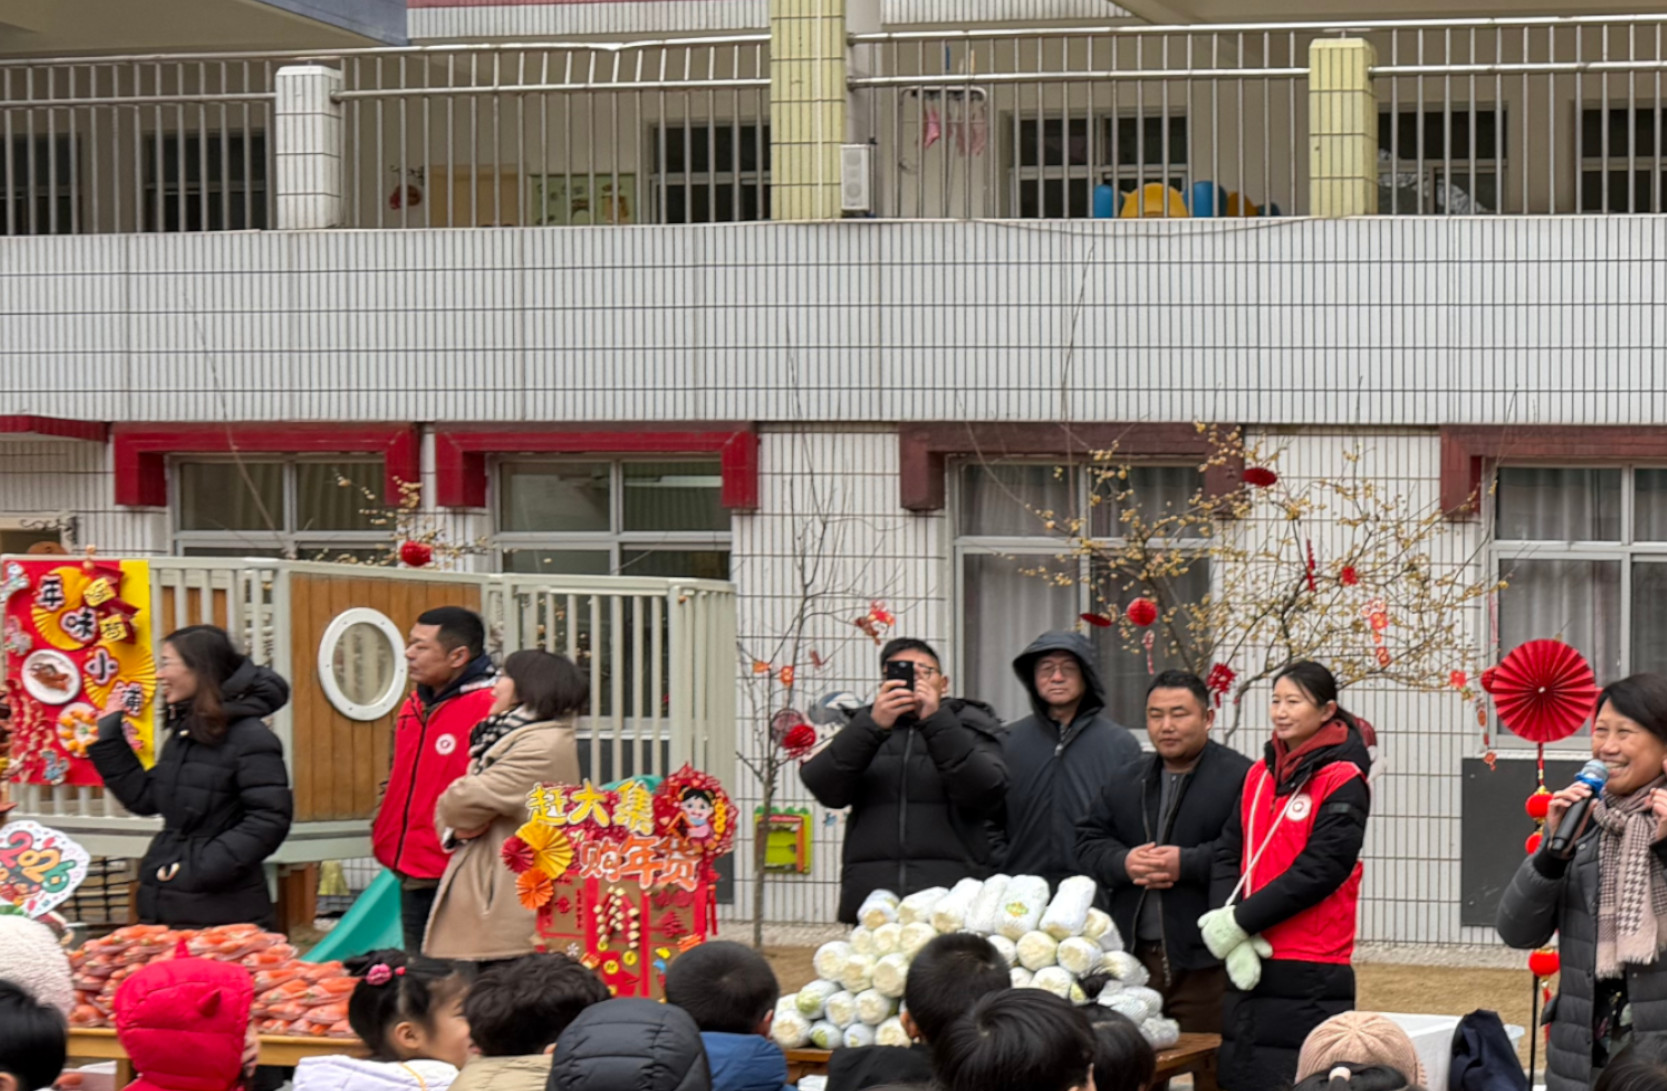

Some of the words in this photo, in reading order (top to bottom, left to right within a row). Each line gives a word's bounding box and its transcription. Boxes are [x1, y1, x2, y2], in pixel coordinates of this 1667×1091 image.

[525, 778, 656, 836] 赶大集
[0, 831, 76, 894] 2026
[580, 835, 703, 892] 购年货
